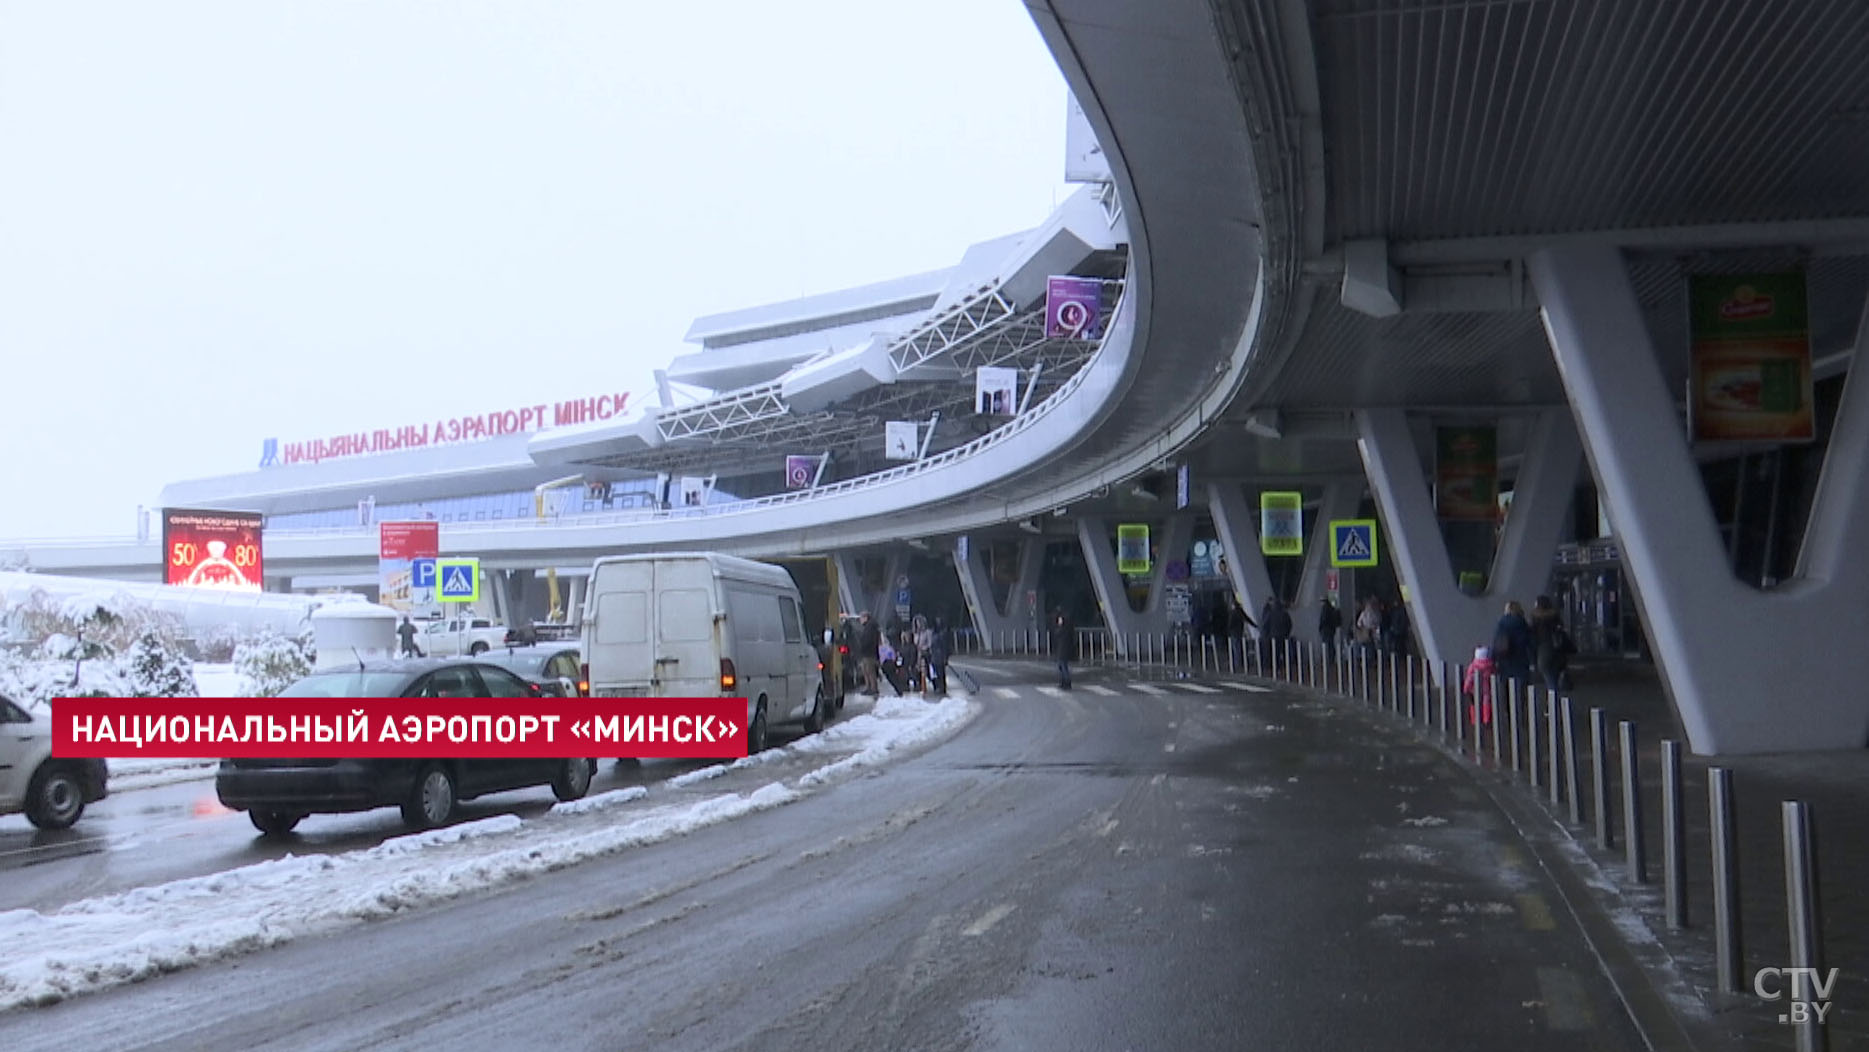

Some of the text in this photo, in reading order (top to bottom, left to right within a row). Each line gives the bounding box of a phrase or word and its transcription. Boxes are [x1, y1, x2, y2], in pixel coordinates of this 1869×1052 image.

[284, 391, 630, 464] НАЦЫЯНАЛЬНЫ АЭРАПОРТ МІНСК
[420, 562, 435, 585] P
